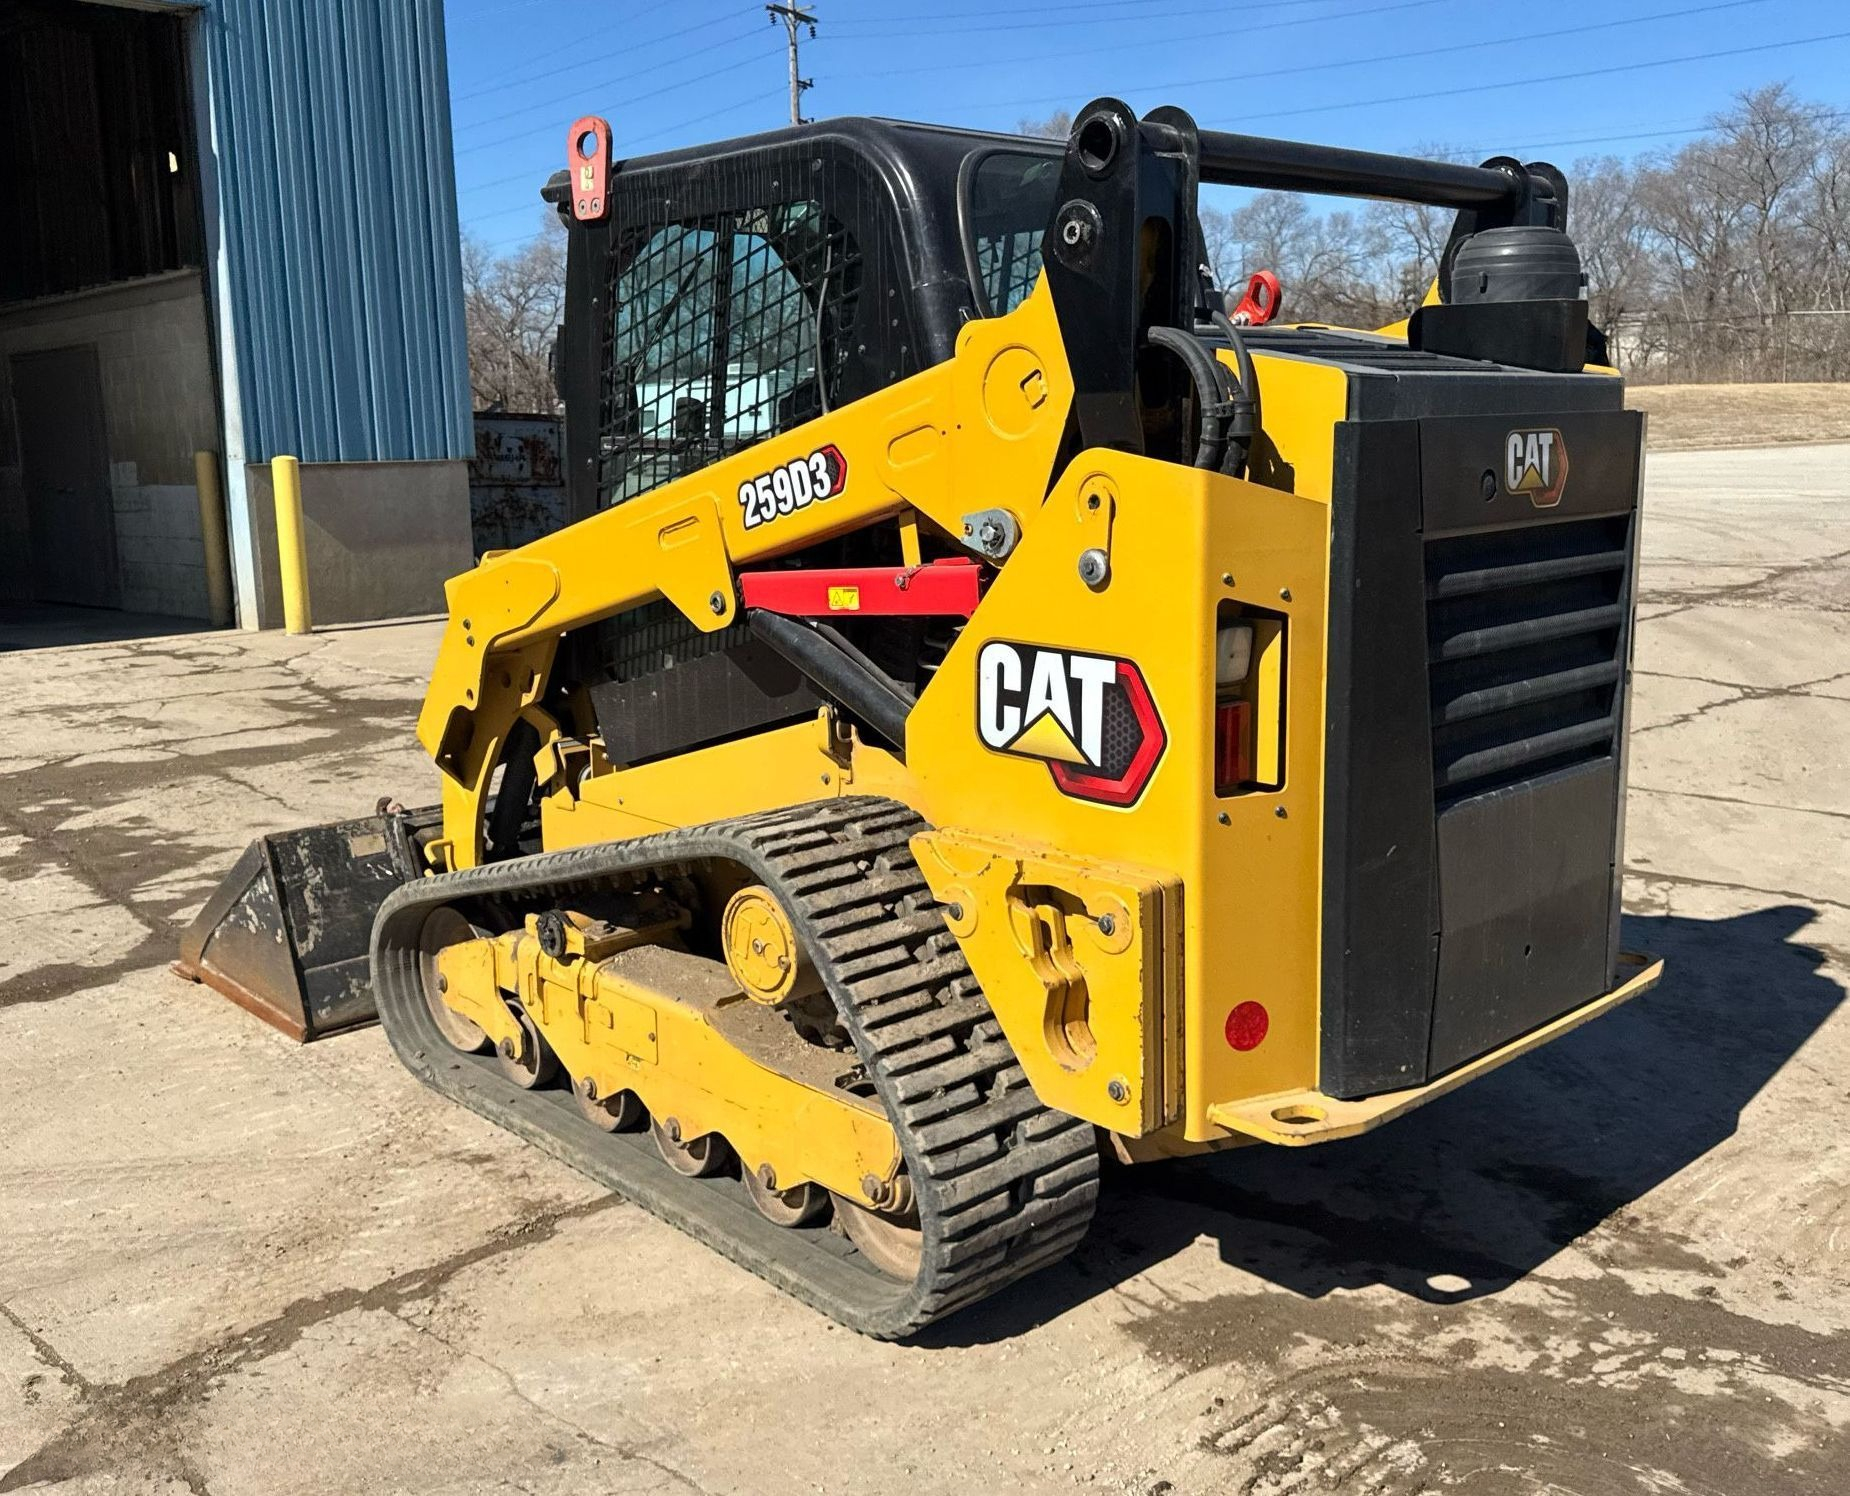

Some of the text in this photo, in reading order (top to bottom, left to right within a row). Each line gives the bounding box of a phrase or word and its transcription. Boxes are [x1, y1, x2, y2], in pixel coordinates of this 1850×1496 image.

[739, 452, 831, 528] 259D3
[1507, 432, 1553, 490] CAT
[980, 643, 1116, 767] CAT
